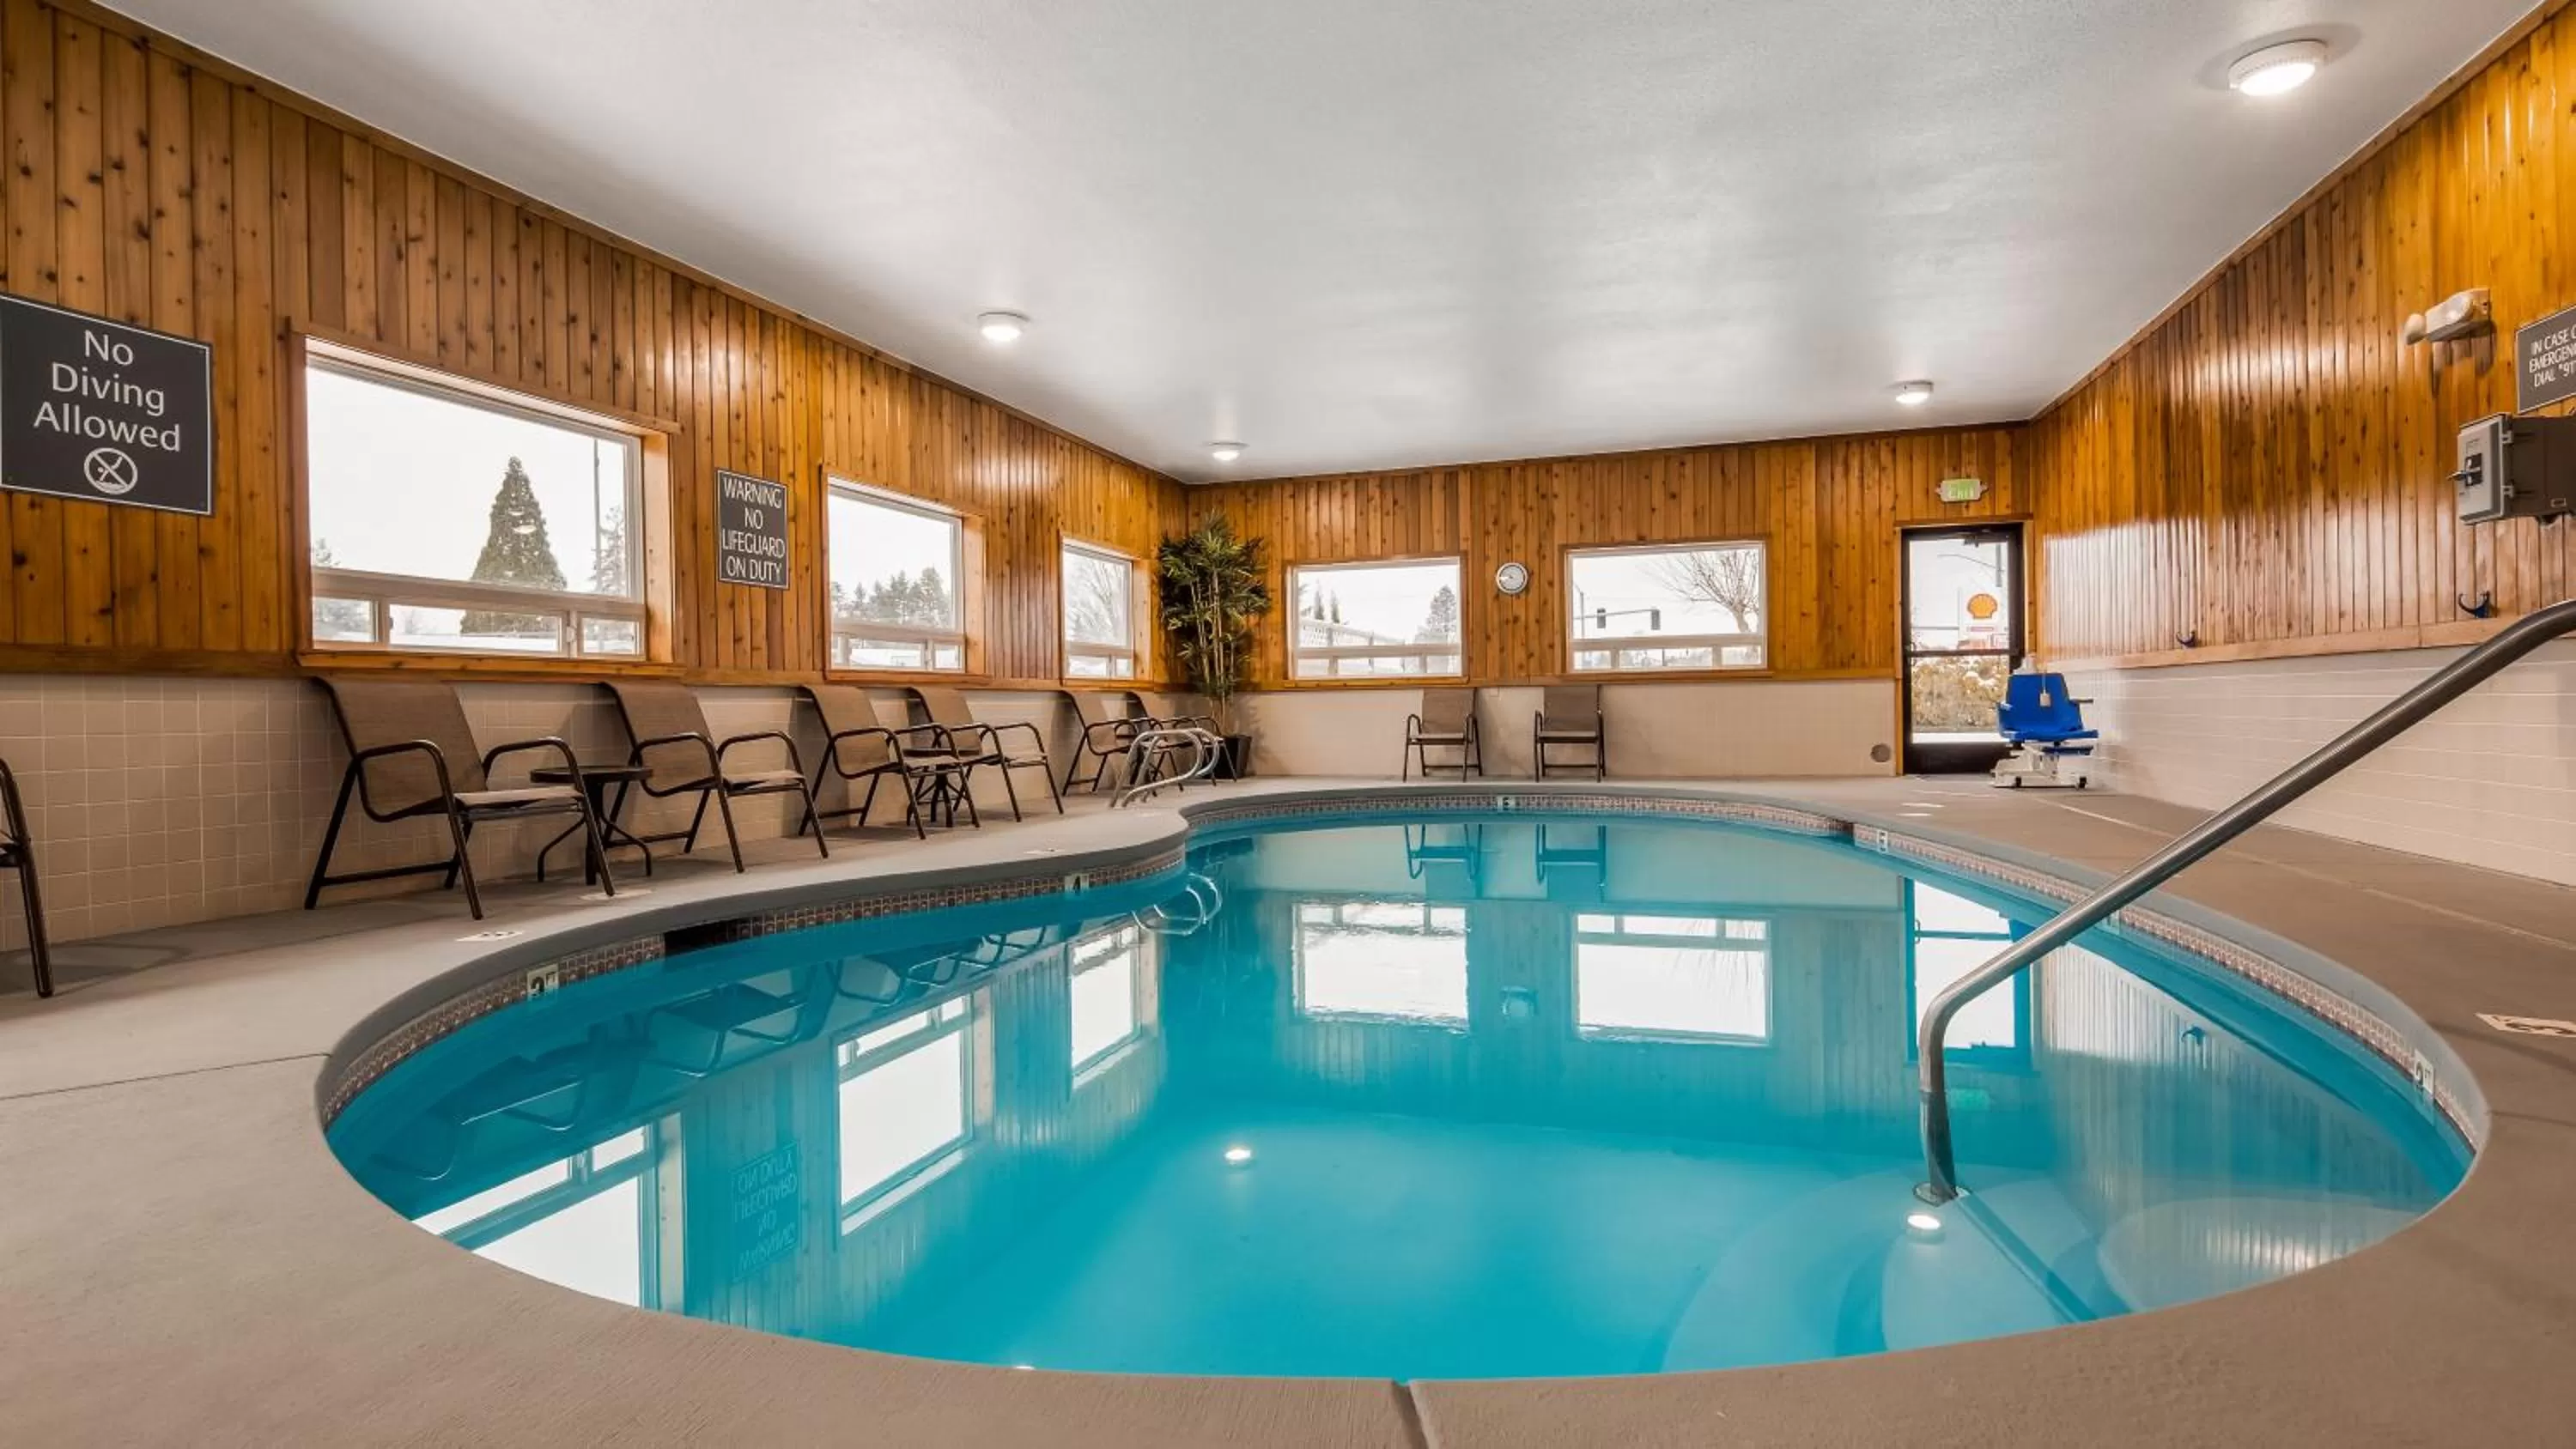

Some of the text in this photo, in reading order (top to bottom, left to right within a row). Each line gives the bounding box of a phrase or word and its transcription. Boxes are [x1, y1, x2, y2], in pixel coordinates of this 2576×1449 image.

[84, 329, 134, 366] No
[2544, 327, 2570, 350] CASE
[2529, 343, 2576, 373] EMERGEN
[52, 361, 165, 416] Diving
[2534, 369, 2556, 387] DIAL
[33, 401, 180, 452] Allowed
[723, 476, 782, 509] WARNING
[744, 507, 764, 530] NO
[721, 528, 786, 559] LIFEGUARD
[726, 555, 783, 583] ON DUTY
